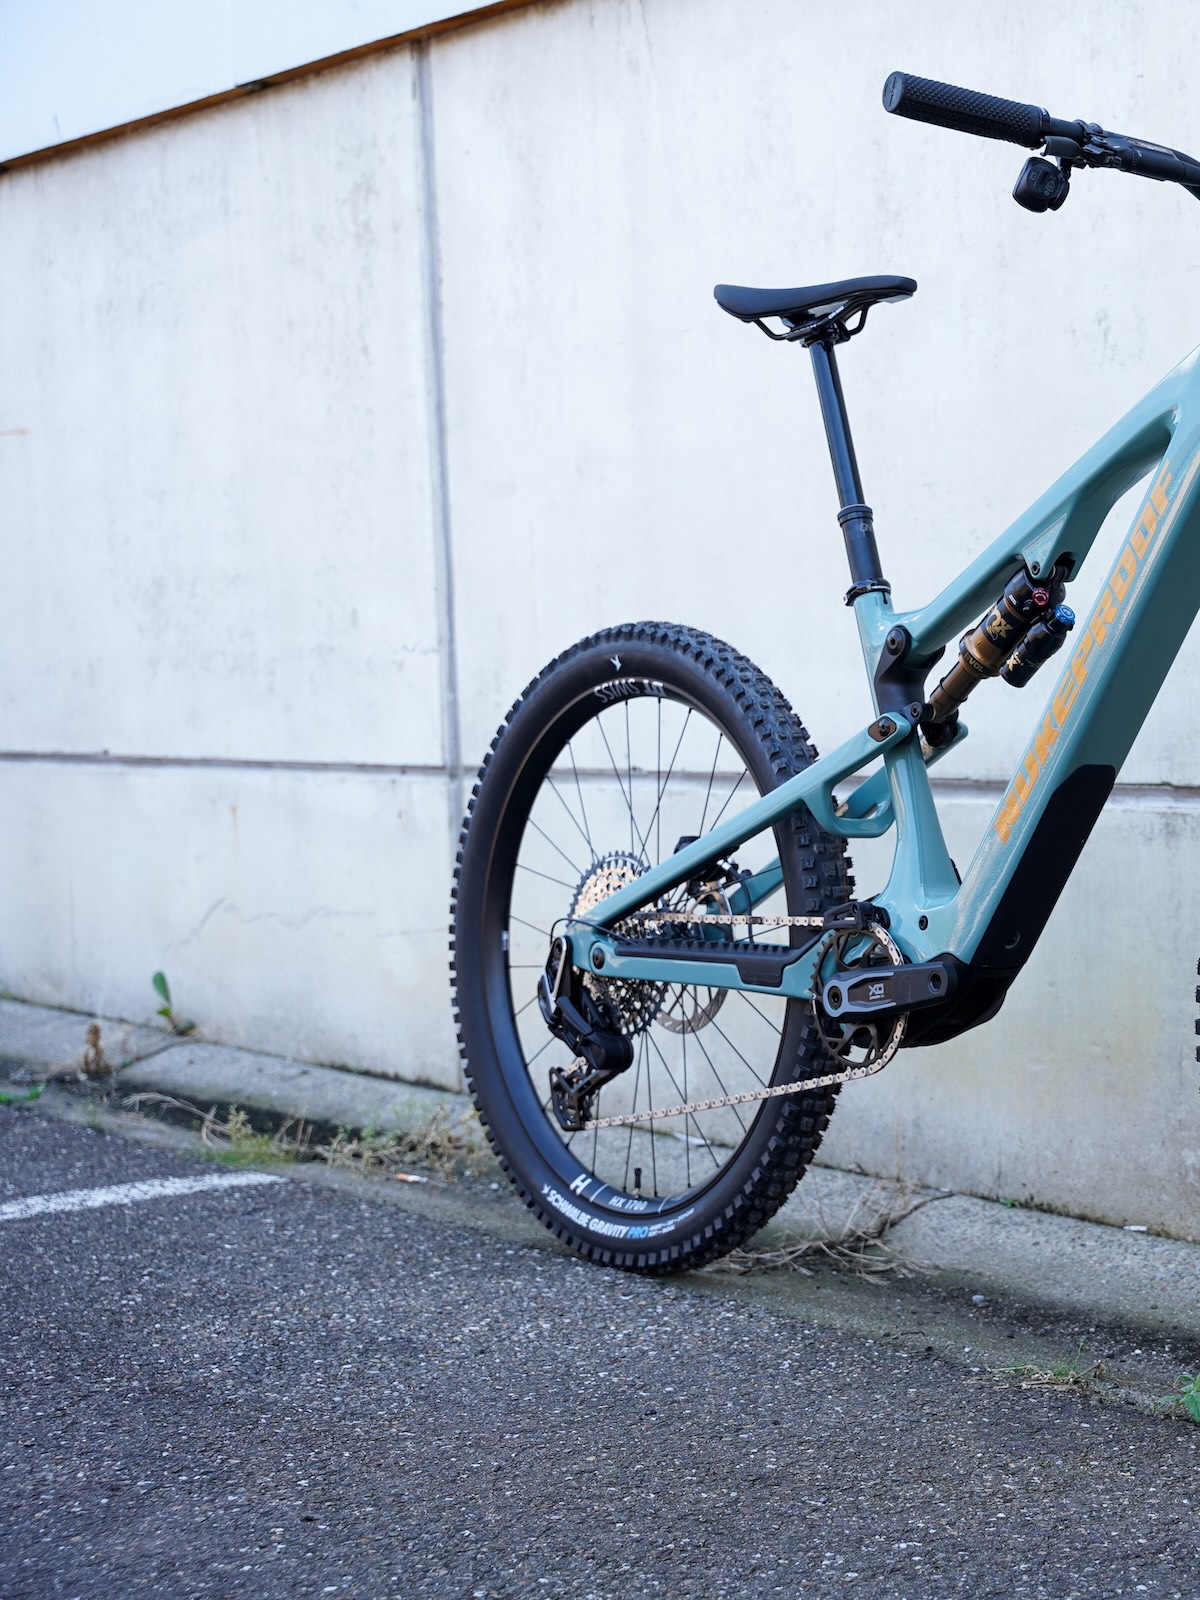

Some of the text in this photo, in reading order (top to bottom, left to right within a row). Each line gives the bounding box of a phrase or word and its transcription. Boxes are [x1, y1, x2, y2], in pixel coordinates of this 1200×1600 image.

[594, 678, 640, 703] SWISS
[546, 1190, 590, 1227] SCHWALBE
[589, 1218, 630, 1238] GRAVITY
[627, 1227, 648, 1238] PRO
[625, 1199, 648, 1211] 1700
